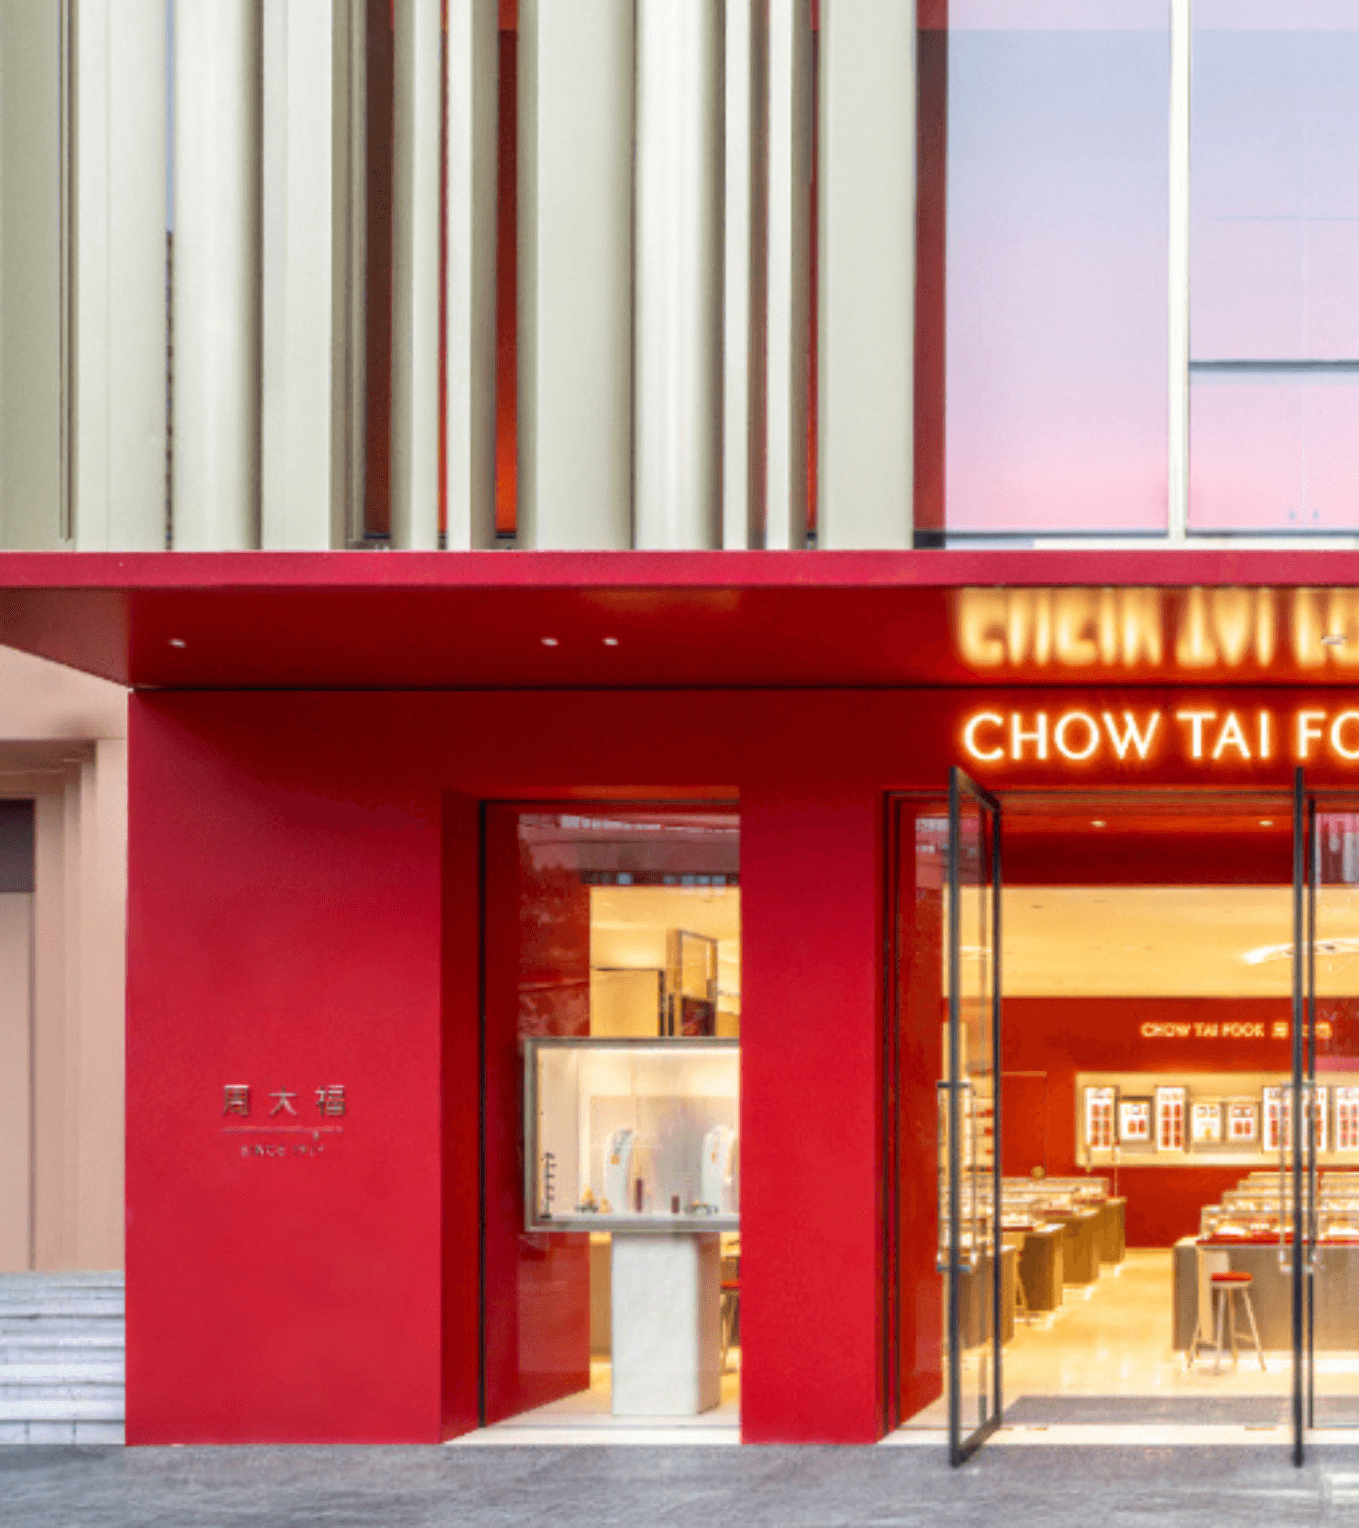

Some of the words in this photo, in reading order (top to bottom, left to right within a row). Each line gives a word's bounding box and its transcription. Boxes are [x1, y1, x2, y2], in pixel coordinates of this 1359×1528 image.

[963, 711, 1161, 761] CHOW
[1176, 711, 1270, 761] TAI
[1141, 1021, 1191, 1038] CHOW
[1194, 1021, 1218, 1038] TAI
[1222, 1021, 1264, 1038] FOOK
[222, 1083, 345, 1117] 周大福
